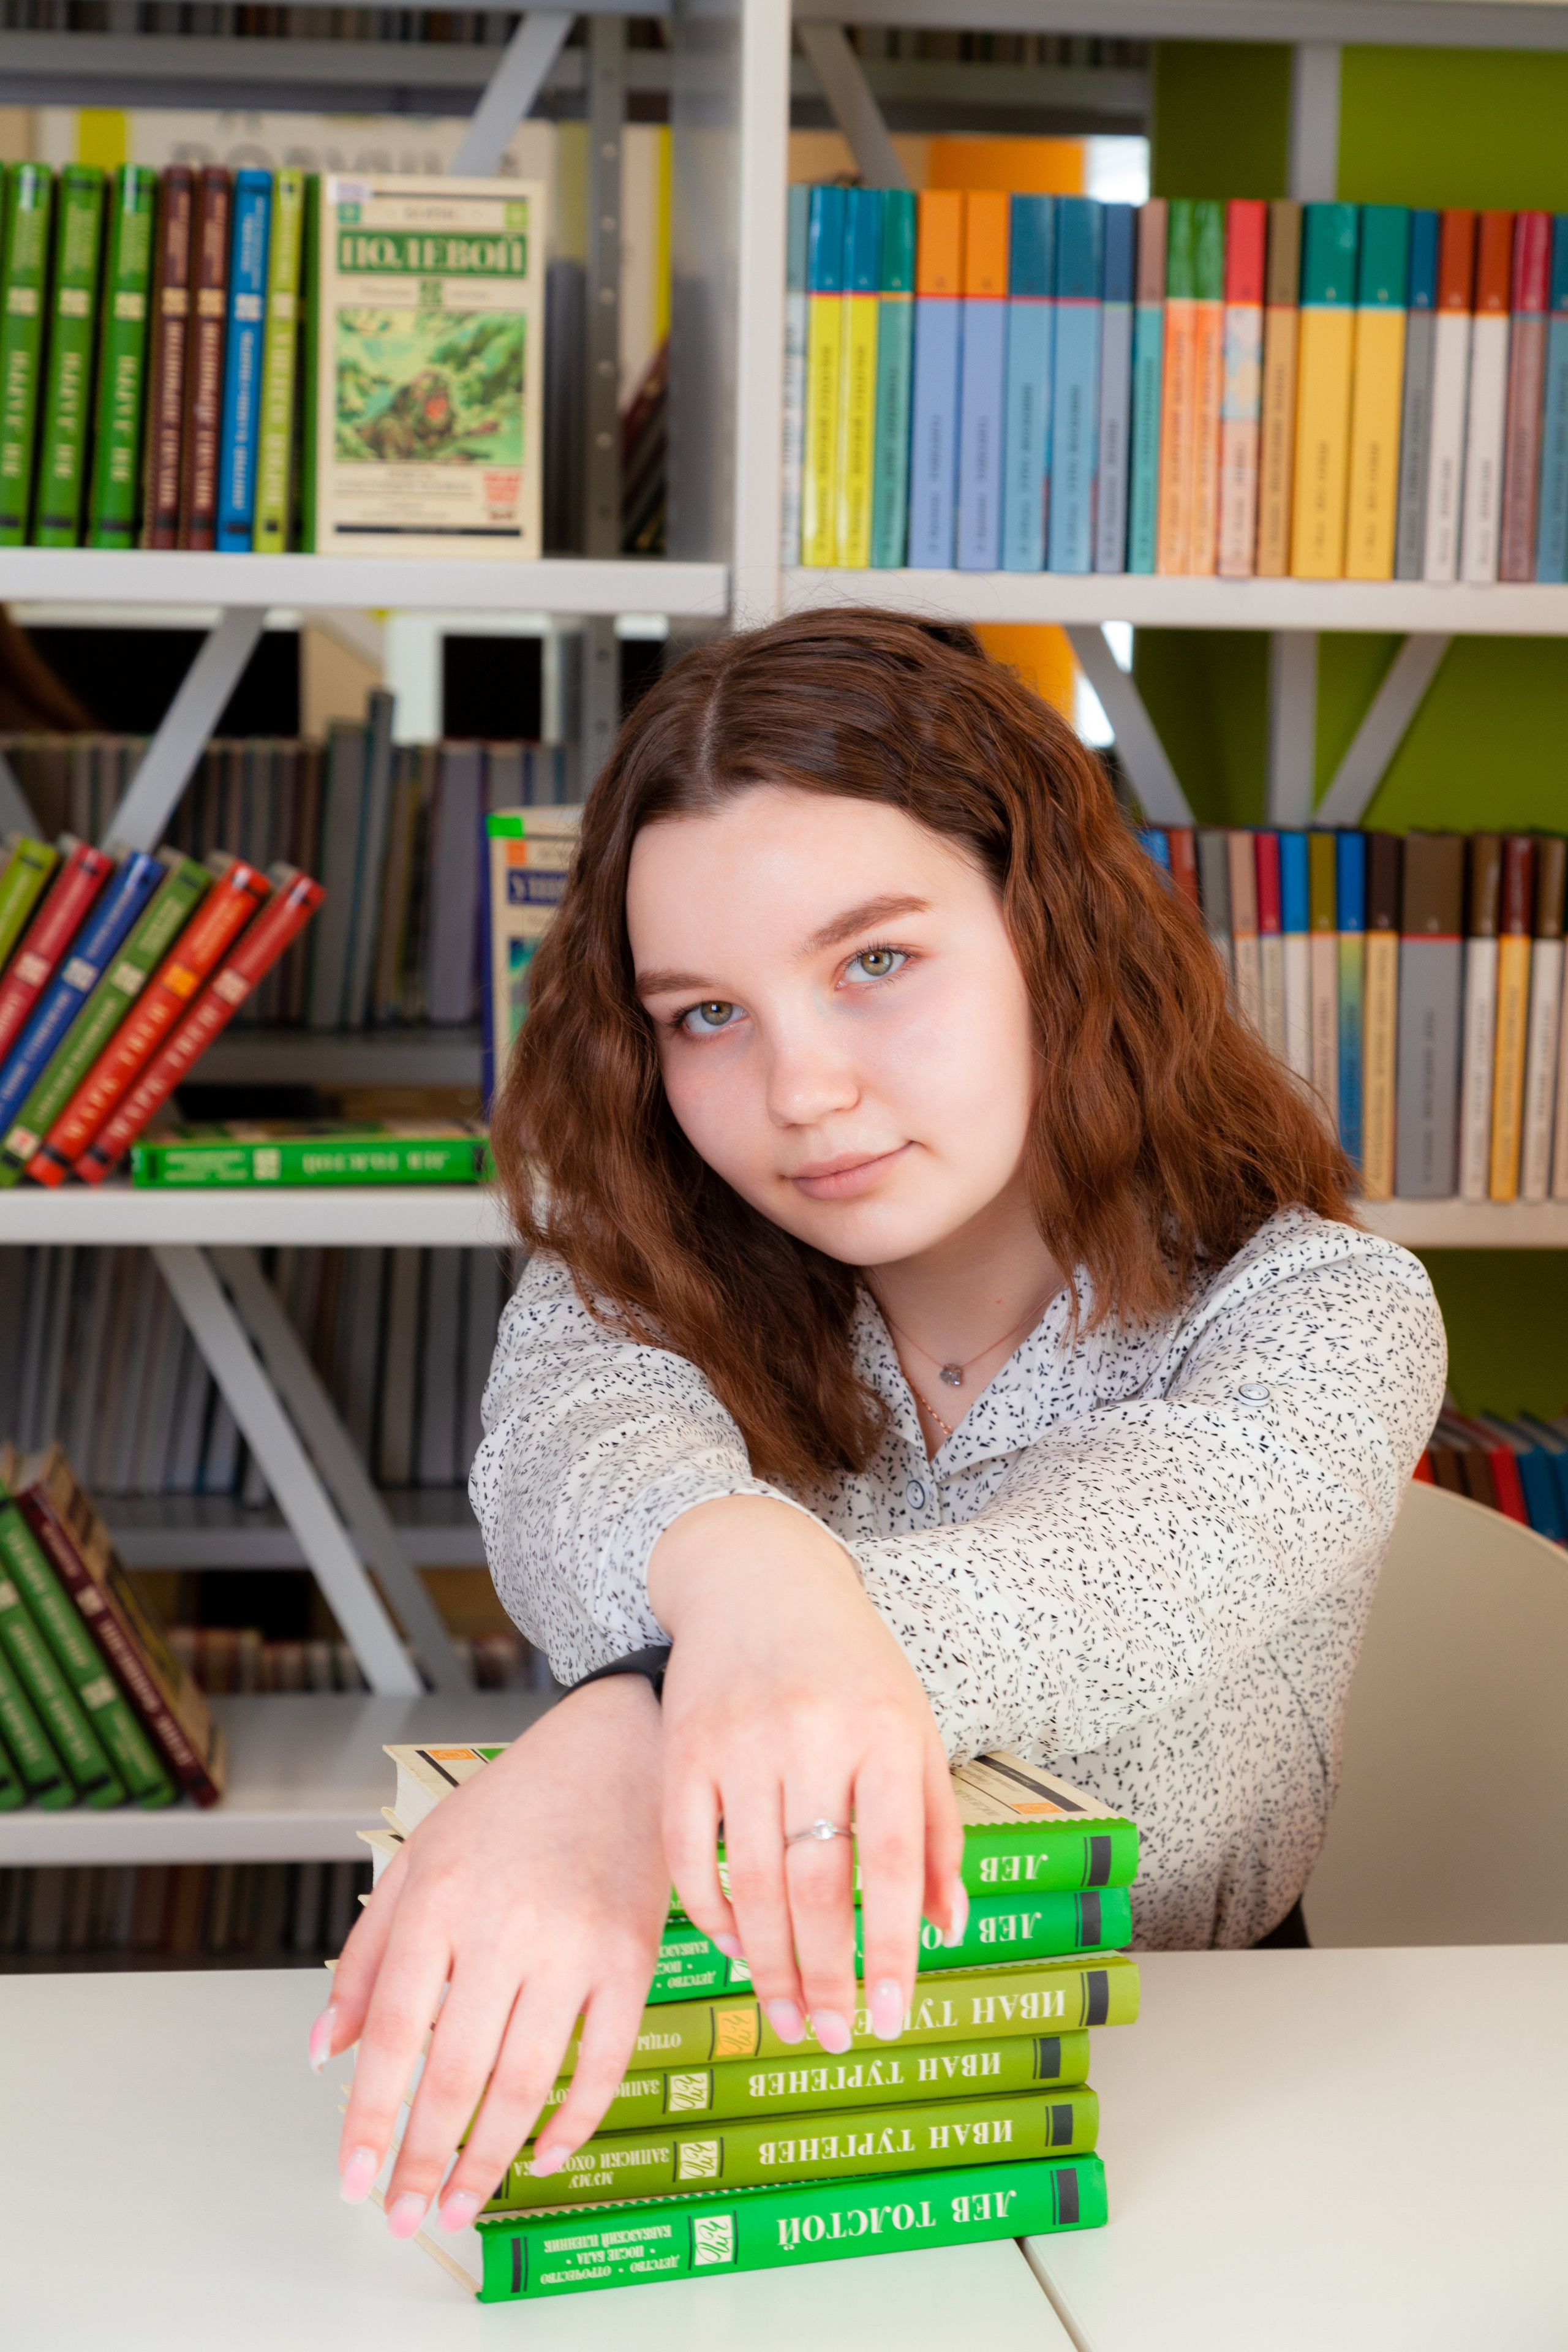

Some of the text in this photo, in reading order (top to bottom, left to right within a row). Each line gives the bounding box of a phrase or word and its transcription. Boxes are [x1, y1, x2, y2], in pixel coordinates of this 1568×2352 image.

[979, 1853, 1048, 1882] ЛЕВ
[978, 1912, 1042, 1943] ЛЕВ
[970, 1989, 1066, 2025] ИВАН
[637, 2032, 682, 2050] ОТЦЫ
[748, 2052, 1001, 2097] ИВАН ТУРГЕНЕВ
[758, 2120, 1013, 2165] ИВАН ТУРГЕНЕВ
[600, 2147, 670, 2168] ЗАПИСКИ
[568, 2171, 613, 2188] МУМУ
[776, 2190, 1017, 2251] ЛЕВ ТОЛСТОЙ
[543, 2225, 672, 2253] КАВКАЗСКИЙ ПЛЕННИК
[540, 2254, 680, 2284] ДЕТСТВО ОТРОЧЕСТВО
[576, 2245, 644, 2264] ПОСЛЕ БАЛА
